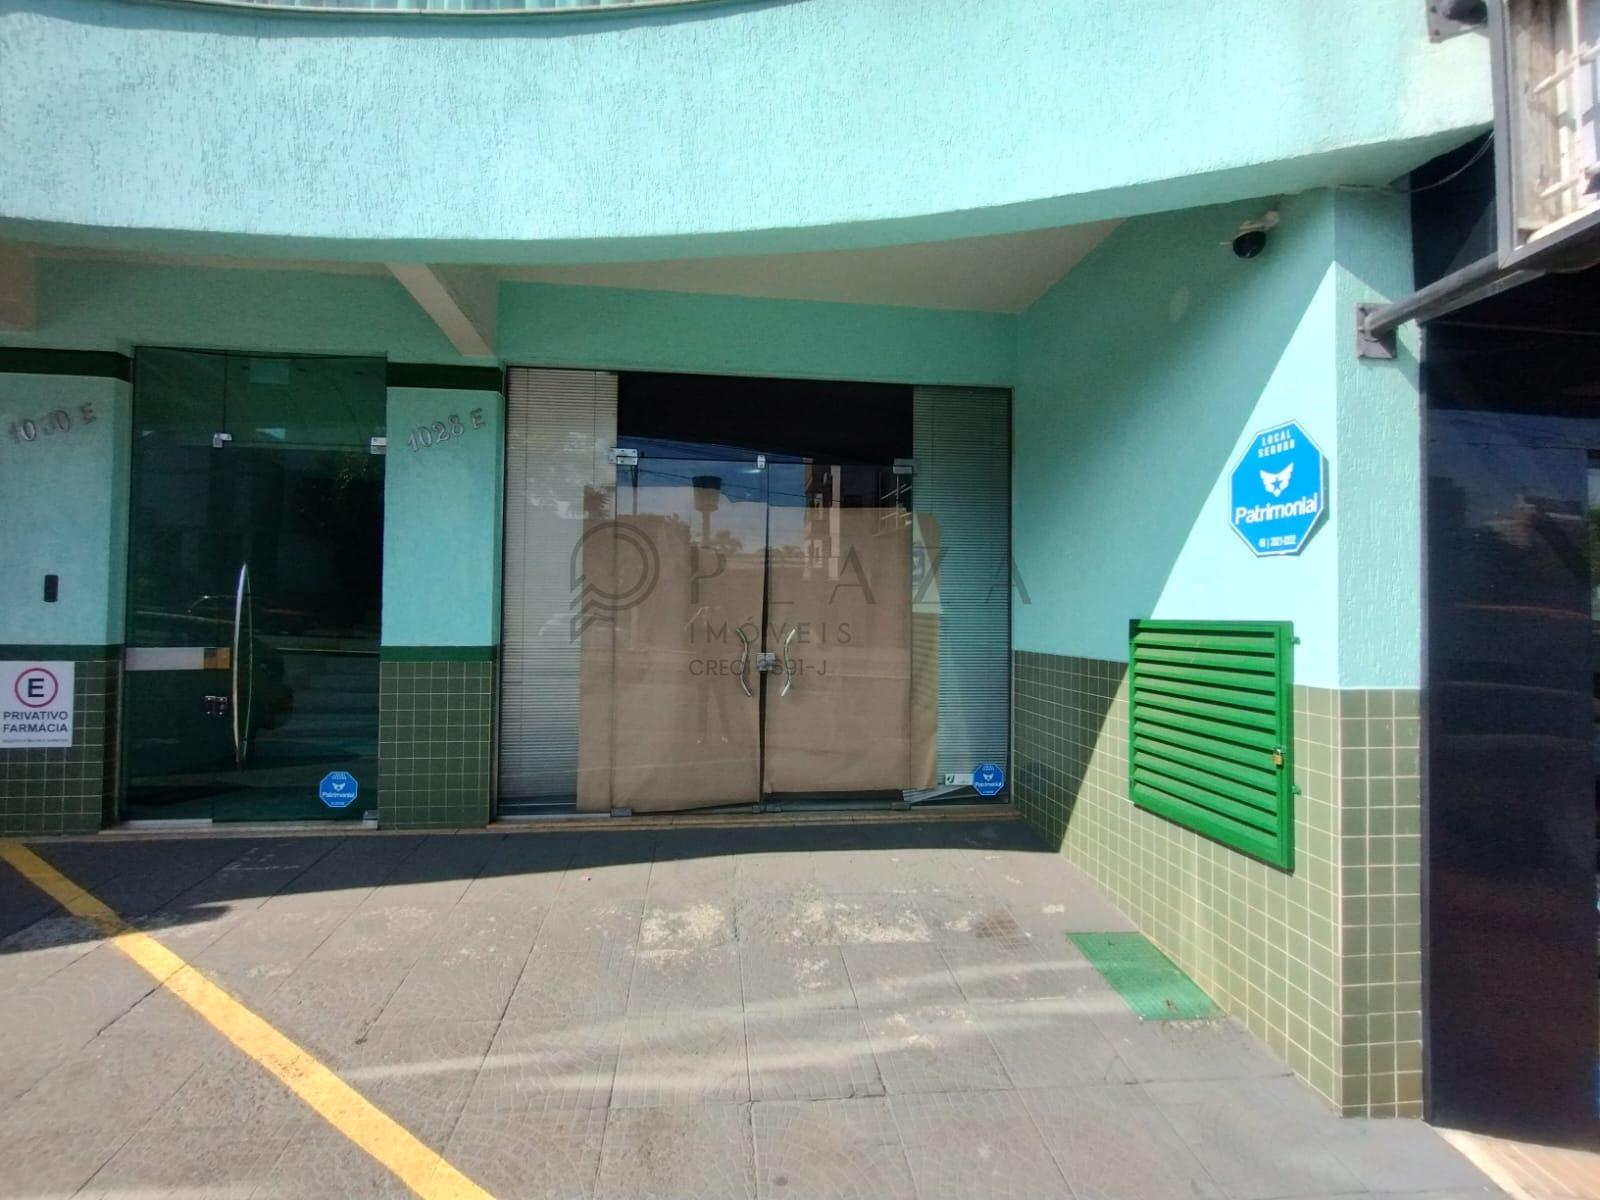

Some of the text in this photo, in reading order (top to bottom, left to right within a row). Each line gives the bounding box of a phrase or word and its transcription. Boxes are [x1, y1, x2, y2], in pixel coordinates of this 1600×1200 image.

[407, 407, 486, 453] 1028 E
[1261, 429, 1292, 447] LOCAL
[1257, 438, 1296, 458] SEGURO
[1235, 491, 1318, 526] Patrimonial
[27, 678, 45, 698] E
[3, 711, 69, 721] PRIVATIVO
